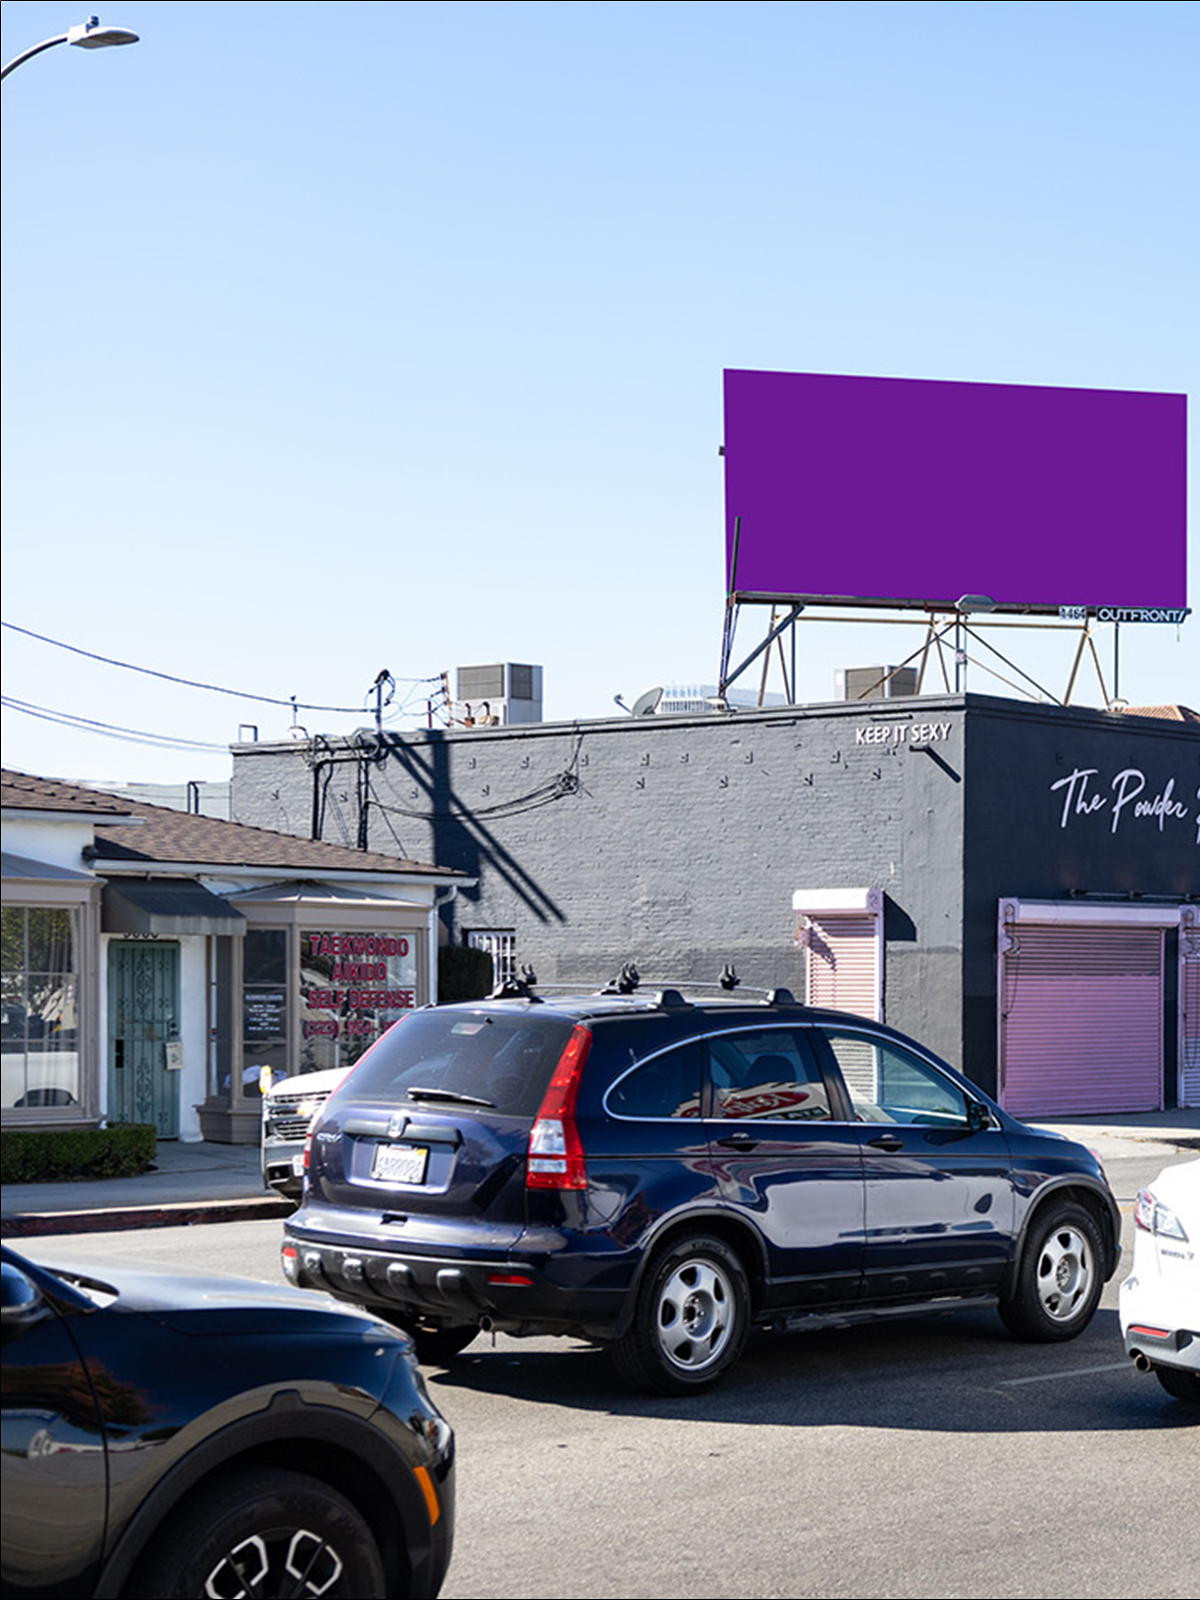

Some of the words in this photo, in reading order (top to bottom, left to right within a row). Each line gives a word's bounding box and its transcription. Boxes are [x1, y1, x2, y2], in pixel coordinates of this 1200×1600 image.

[856, 726, 892, 745] KEEP
[894, 725, 909, 742] IT
[911, 722, 953, 742] SEXY
[1050, 768, 1107, 828] The
[1111, 768, 1188, 833] Powder
[309, 935, 409, 957] TAEKWONDO
[331, 962, 388, 981] AIKIDO
[307, 989, 346, 1009] SELF
[349, 990, 415, 1009] DEFENSE
[304, 1020, 341, 1039] (323)
